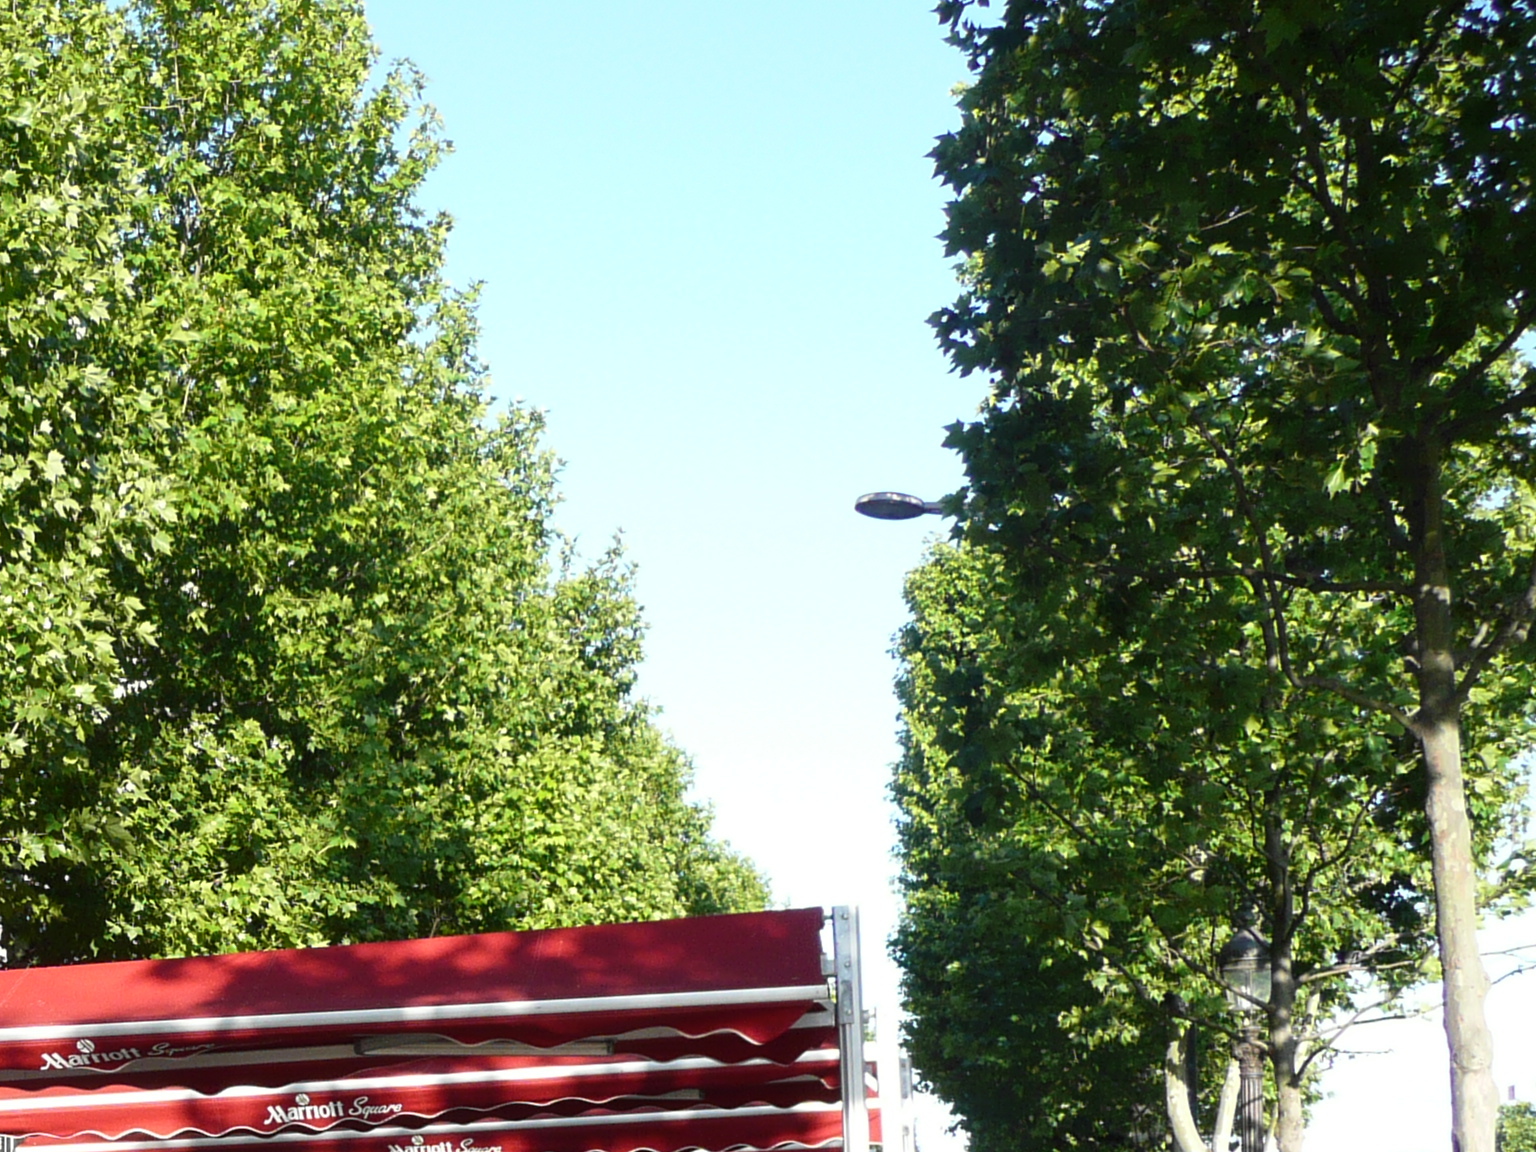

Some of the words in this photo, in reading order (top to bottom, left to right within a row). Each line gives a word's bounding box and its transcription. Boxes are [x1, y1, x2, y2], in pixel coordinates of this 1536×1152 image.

[40, 1047, 142, 1071] Marriott
[263, 1100, 344, 1125] Marriott
[348, 1096, 403, 1119] Square
